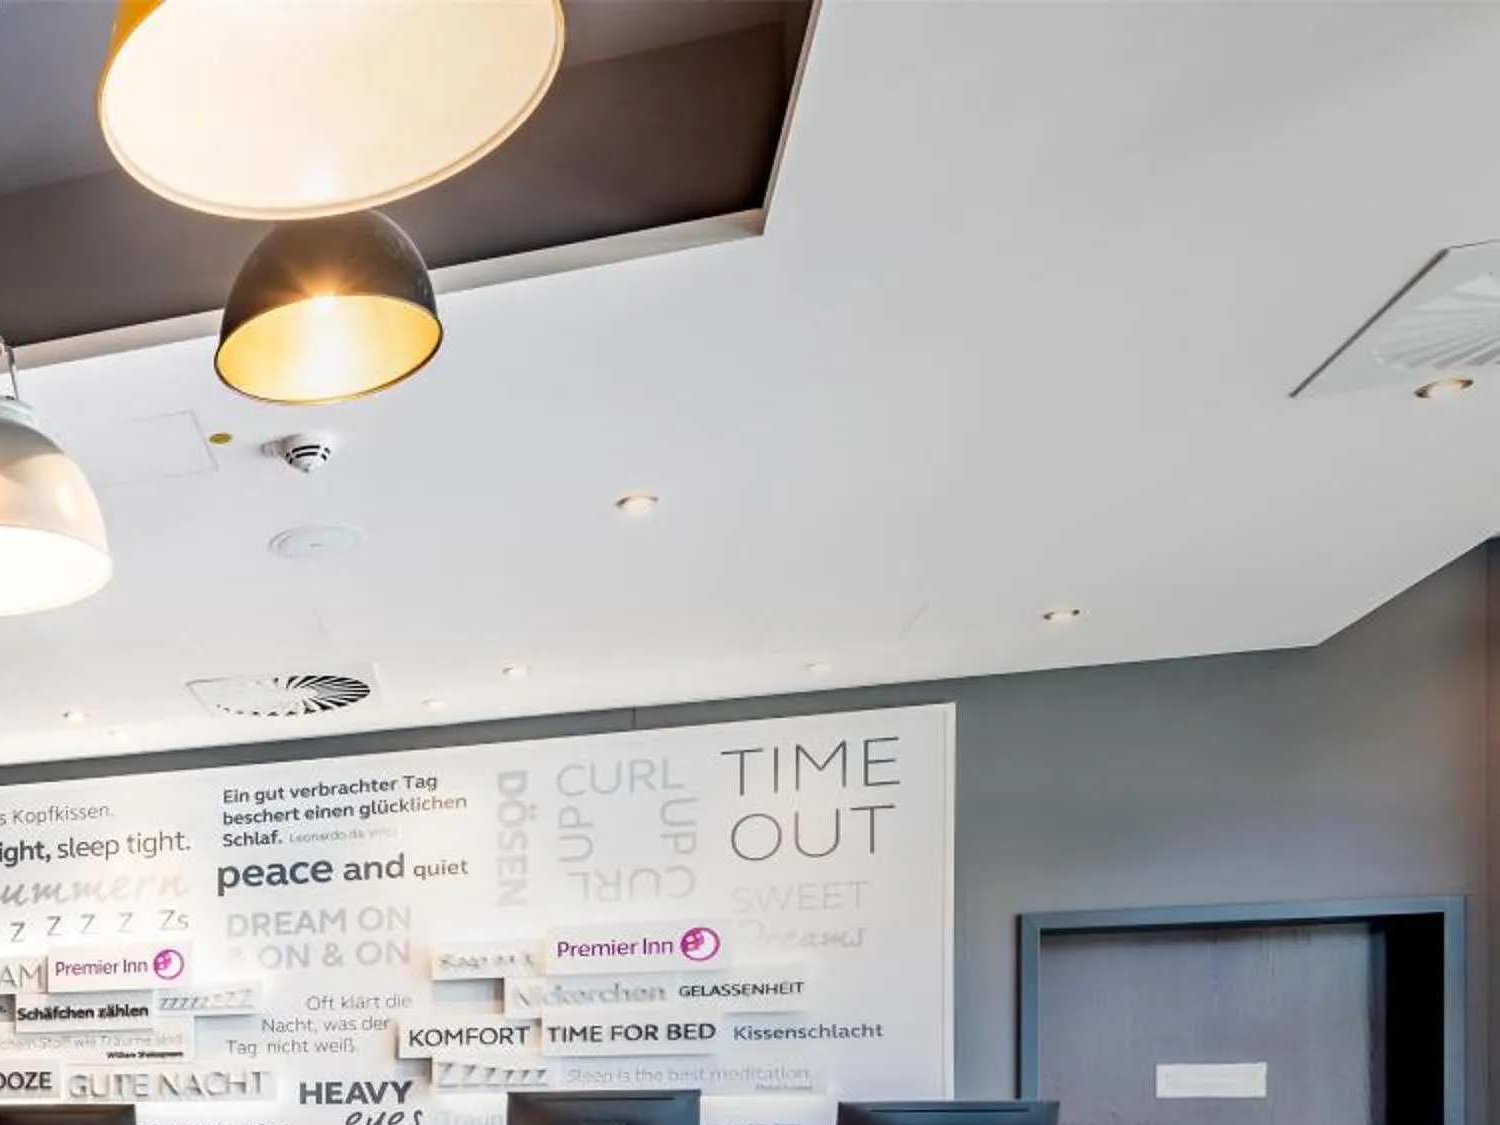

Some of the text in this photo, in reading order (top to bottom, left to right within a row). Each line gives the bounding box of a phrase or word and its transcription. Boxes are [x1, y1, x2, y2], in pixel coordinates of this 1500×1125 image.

[721, 737, 900, 796] TIME
[556, 758, 685, 798] CURL
[223, 775, 437, 805] Ein gut verbrachter Tag
[223, 796, 467, 825] beschert einen glücklichen
[223, 831, 283, 847] Schlaf.
[731, 805, 896, 861] OUT
[56, 837, 119, 861] sleep
[127, 830, 192, 859] tight.
[217, 853, 468, 896] peace and quiet
[227, 906, 412, 937] DREAM ON
[257, 944, 310, 969] ON
[355, 940, 411, 966] ON
[557, 938, 673, 957] Premier Inn
[55, 959, 149, 977] Premier Inn
[679, 982, 805, 997] GELASSENHEIT
[306, 996, 334, 1010] Oft
[386, 992, 412, 1008] die
[17, 1004, 149, 1021] Schäfchen zählen
[324, 1020, 357, 1030] was
[362, 1017, 390, 1030] der
[548, 1022, 716, 1042] TIME FOR BED
[733, 1022, 884, 1040] Kissenschlacht
[408, 1025, 530, 1046] KOMFORT
[228, 1040, 258, 1056] Tag
[267, 1038, 309, 1053] nicht
[68, 1071, 268, 1099] GUTE NACHT
[300, 1082, 411, 1104] HEAVY
